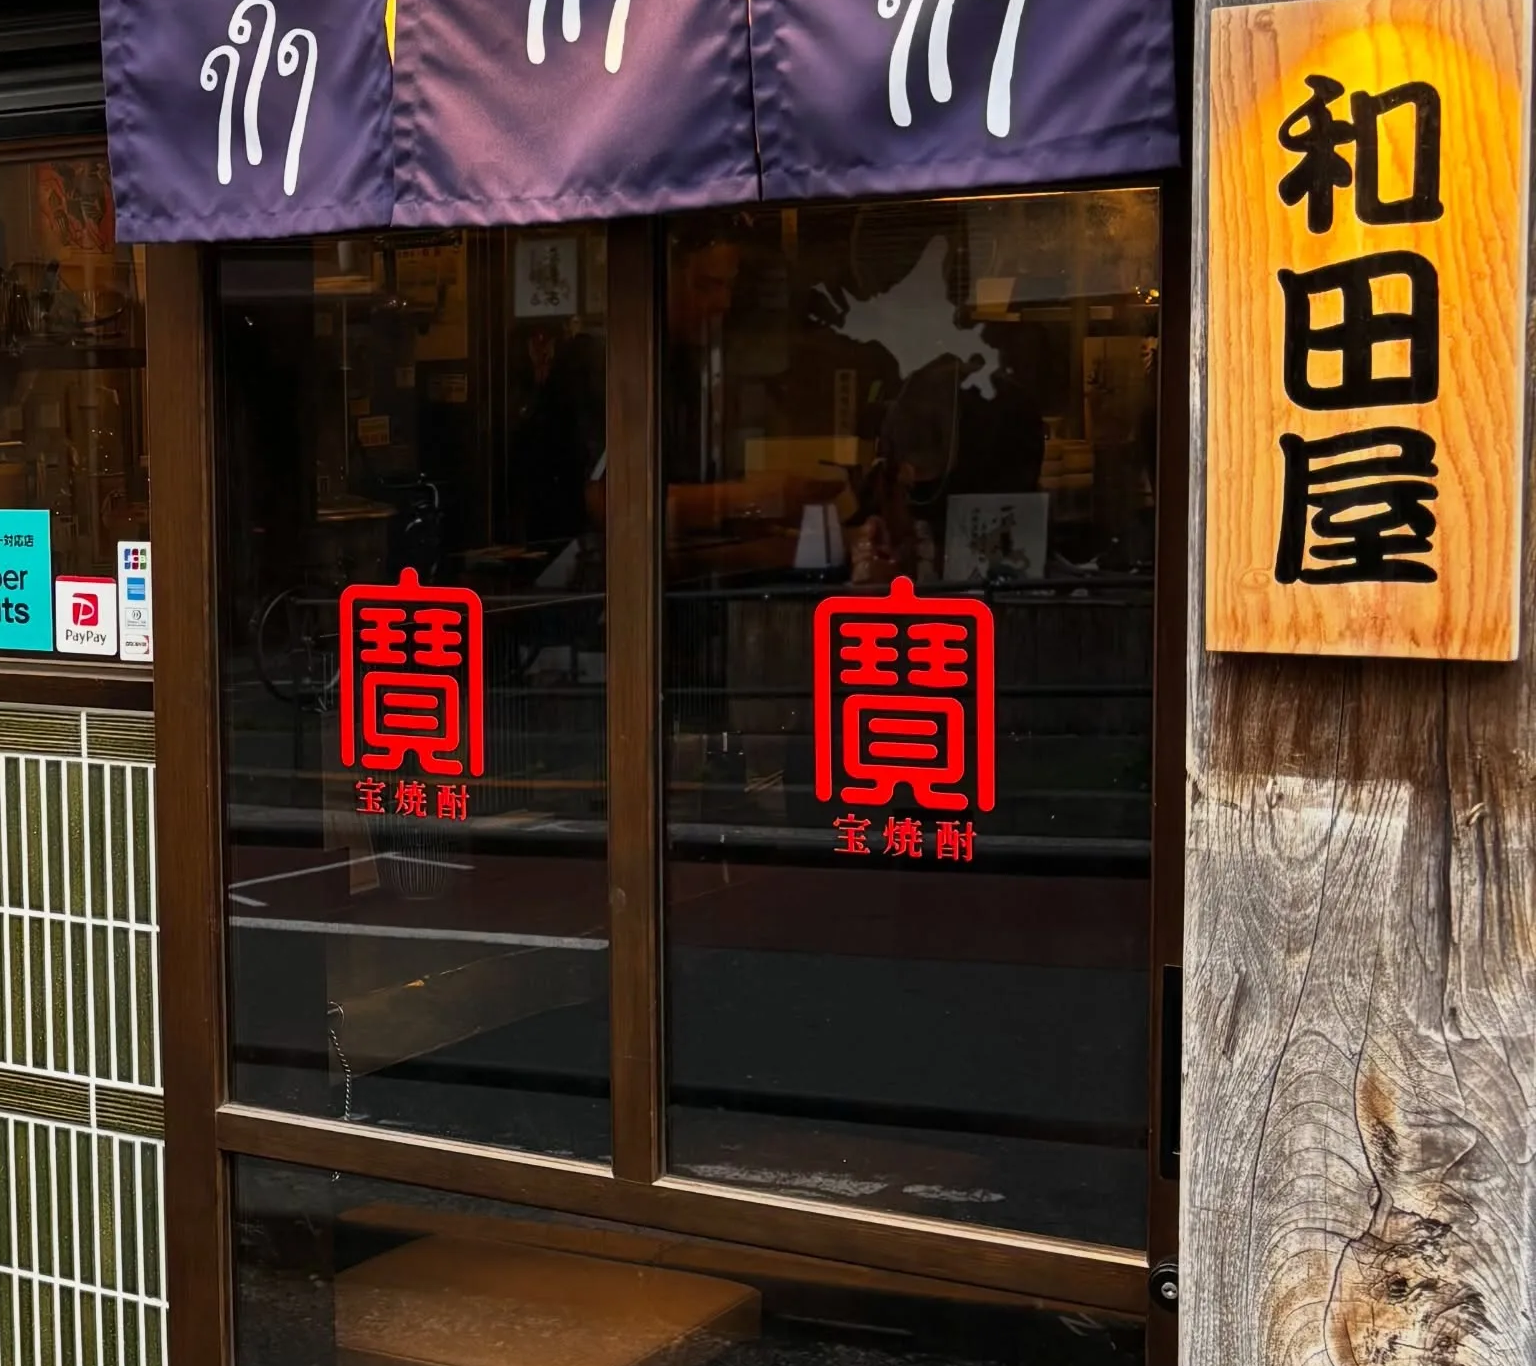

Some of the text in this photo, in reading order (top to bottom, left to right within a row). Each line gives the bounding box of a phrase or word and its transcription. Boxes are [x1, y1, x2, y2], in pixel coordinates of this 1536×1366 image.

[1276, 73, 1444, 586] 和田屋
[65, 629, 108, 646] PayPay
[353, 777, 471, 822] 宝焼酎
[832, 816, 978, 863] 宝焼酎
